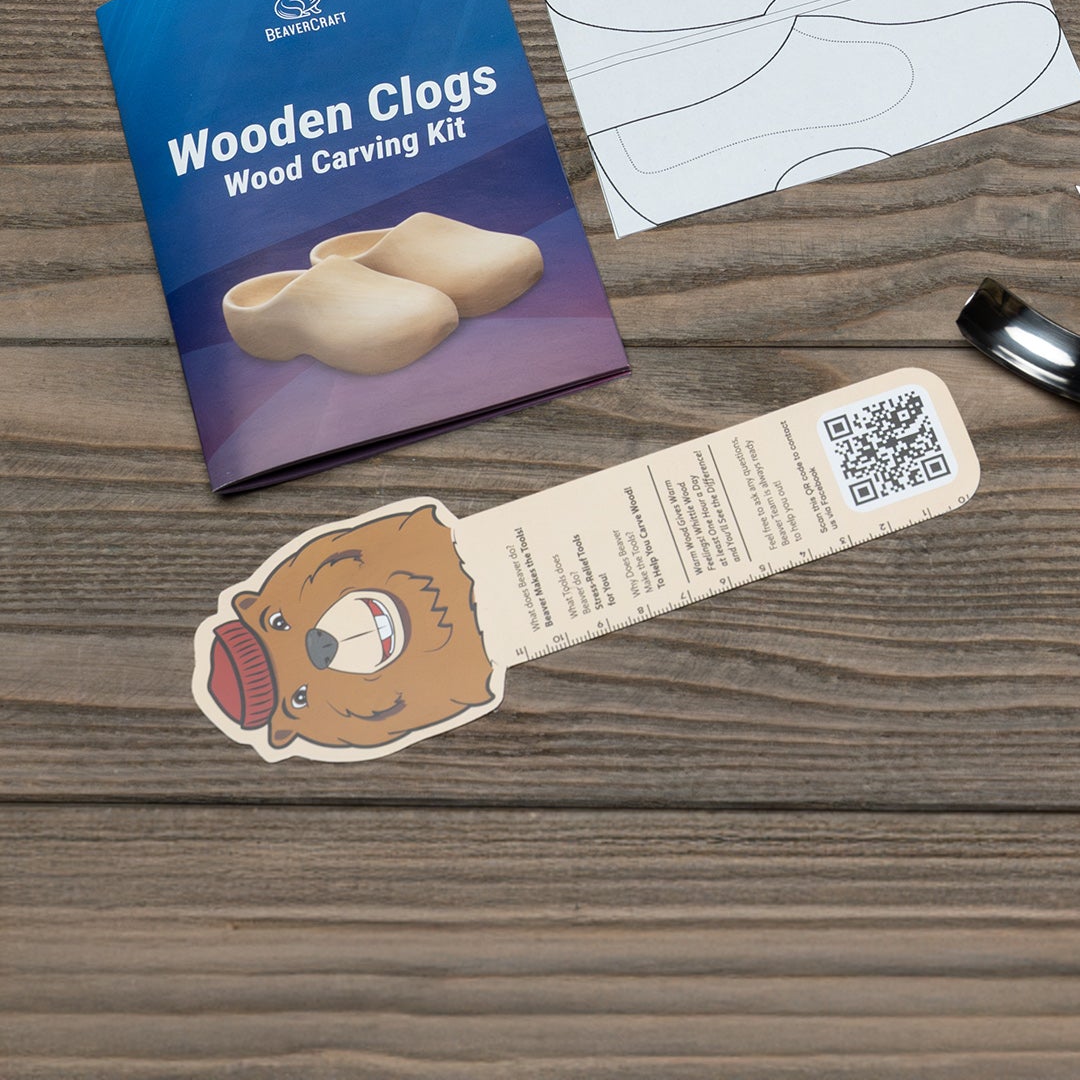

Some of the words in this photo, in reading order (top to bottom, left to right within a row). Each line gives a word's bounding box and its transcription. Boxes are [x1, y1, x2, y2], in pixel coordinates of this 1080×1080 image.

[168, 103, 352, 176] Wooden
[369, 65, 496, 121] Clogs
[224, 156, 302, 197] Wood
[312, 133, 418, 173] Carving
[427, 116, 466, 145] Kit
[779, 419, 797, 452] contact
[731, 436, 752, 477] questions,
[744, 439, 759, 463] ready
[792, 450, 801, 462] to
[692, 449, 717, 494] Difference!
[752, 461, 769, 489] always
[795, 460, 810, 482] code
[664, 479, 679, 505] Warm
[675, 480, 693, 506] Wood
[689, 474, 704, 492] Day
[693, 489, 705, 499] a
[745, 477, 757, 493] any
[762, 488, 772, 498] is
[772, 479, 786, 497] out!
[802, 481, 816, 497] QR
[808, 466, 830, 507] Facebook
[623, 485, 641, 516] Wood!
[696, 497, 712, 519] Hour
[707, 493, 723, 510] the
[749, 490, 763, 507] ask
[765, 496, 780, 521] Team
[780, 496, 794, 514] you
[809, 495, 821, 513] this
[672, 503, 687, 527] Gives
[685, 504, 705, 537] Whittle
[715, 507, 728, 525] See
[756, 505, 768, 517] to
[815, 511, 829, 534] Scan
[823, 505, 835, 520] via
[634, 513, 650, 541] Carve
[705, 518, 718, 537] One
[760, 515, 773, 534] free
[774, 519, 791, 547] Beaver
[785, 512, 800, 534] help
[829, 519, 839, 531] us
[513, 526, 530, 554] Tools!
[571, 533, 586, 559] Tools
[612, 529, 628, 558] Beaver
[624, 530, 641, 558] Tools?
[642, 538, 655, 558] You
[678, 524, 695, 552] Wood
[710, 535, 726, 558] least
[763, 532, 779, 551] Feel
[793, 531, 803, 543] to
[505, 543, 519, 560] do?
[523, 551, 535, 569] the
[635, 555, 647, 571] the
[695, 535, 717, 572] Feelings!
[718, 556, 729, 568] at
[727, 546, 742, 564] and
[512, 560, 528, 589] Beaver
[551, 553, 565, 575] does
[621, 556, 636, 580] Does
[648, 555, 663, 579] Help
[689, 550, 704, 577] Warm
[528, 567, 544, 597] Makes
[557, 573, 573, 598] Tools
[568, 570, 583, 589] do?
[577, 556, 605, 611] Stress-Relief
[597, 572, 612, 594] You!
[629, 578, 642, 599] Why
[640, 569, 654, 594] Make
[656, 576, 667, 591] To
[521, 587, 535, 609] does
[564, 595, 579, 620] What
[573, 586, 592, 616] Beaver
[605, 592, 617, 607] for
[527, 608, 542, 633] What
[538, 597, 555, 629] Beaver
